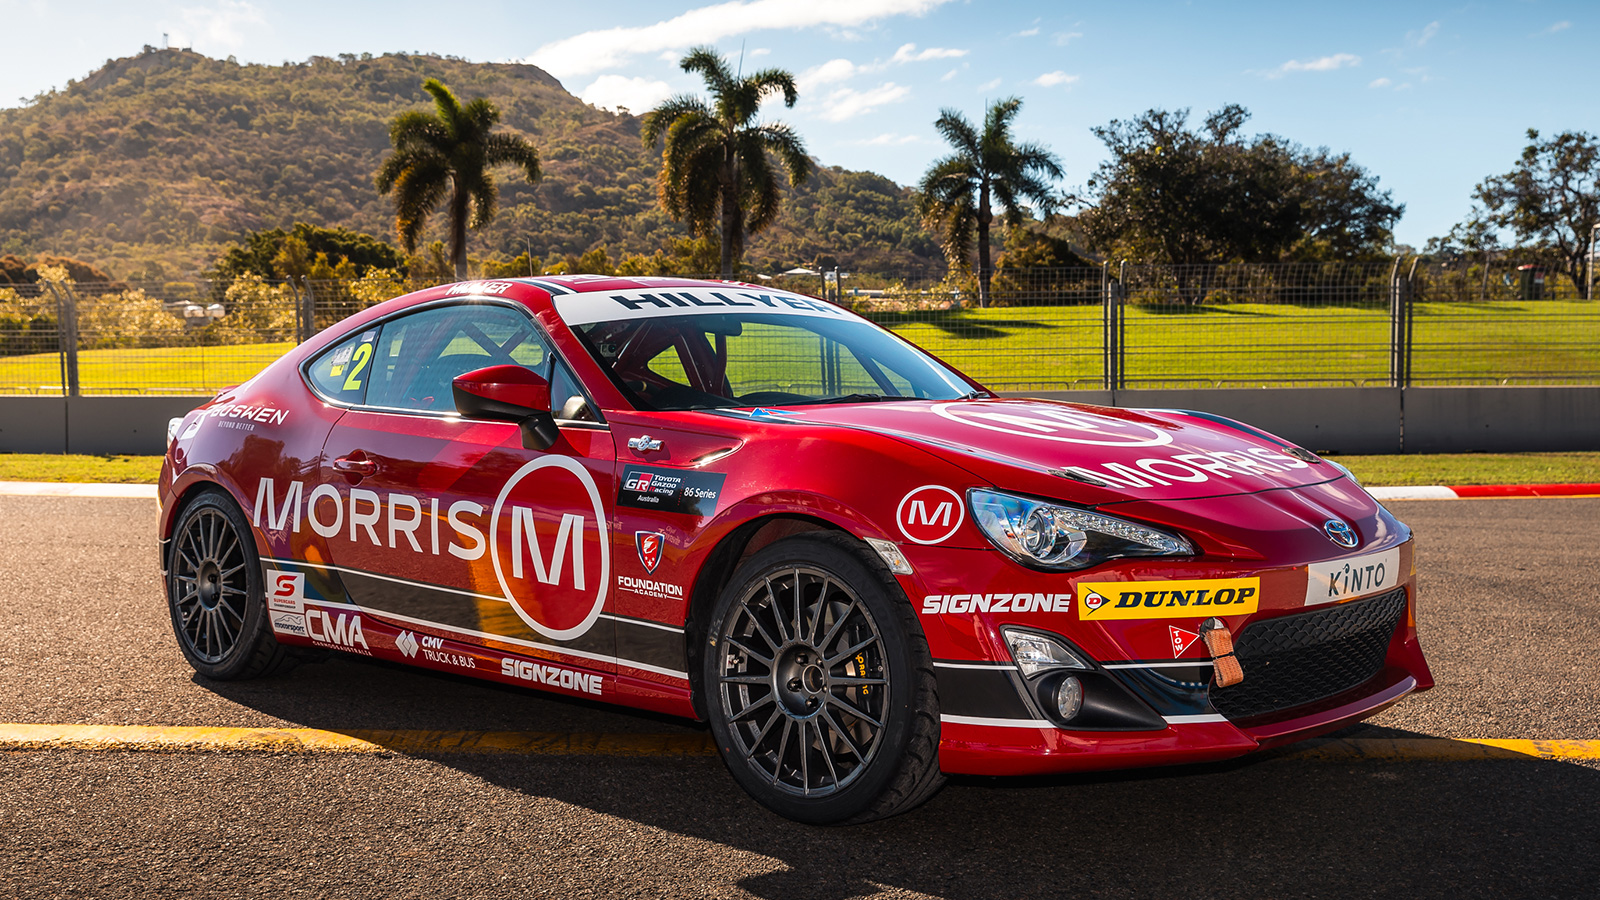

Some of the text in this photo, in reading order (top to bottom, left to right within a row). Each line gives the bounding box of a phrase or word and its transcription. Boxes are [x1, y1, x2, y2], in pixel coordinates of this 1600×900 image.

[608, 292, 841, 314] HILLYER
[342, 343, 372, 390] 2
[654, 474, 681, 483] TOYOTA
[1060, 448, 1309, 489] MORRIS
[625, 479, 649, 491] GR
[649, 486, 674, 496] Racing
[684, 487, 716, 499] 86 Series
[637, 495, 659, 503] Australia
[253, 477, 487, 561] MORRIS
[908, 500, 953, 527] M
[511, 505, 586, 591] M
[617, 575, 683, 596] FOUNDATION
[634, 588, 668, 599] ACADEMY
[921, 593, 1072, 614] SIGNZONE
[1114, 587, 1256, 608] DUNLOP
[305, 609, 370, 650] CMA
[421, 636, 444, 649] CMV
[1173, 630, 1183, 651] TOW
[422, 649, 476, 669] TRUCK & BUS
[501, 657, 603, 695] SIGNZONE
